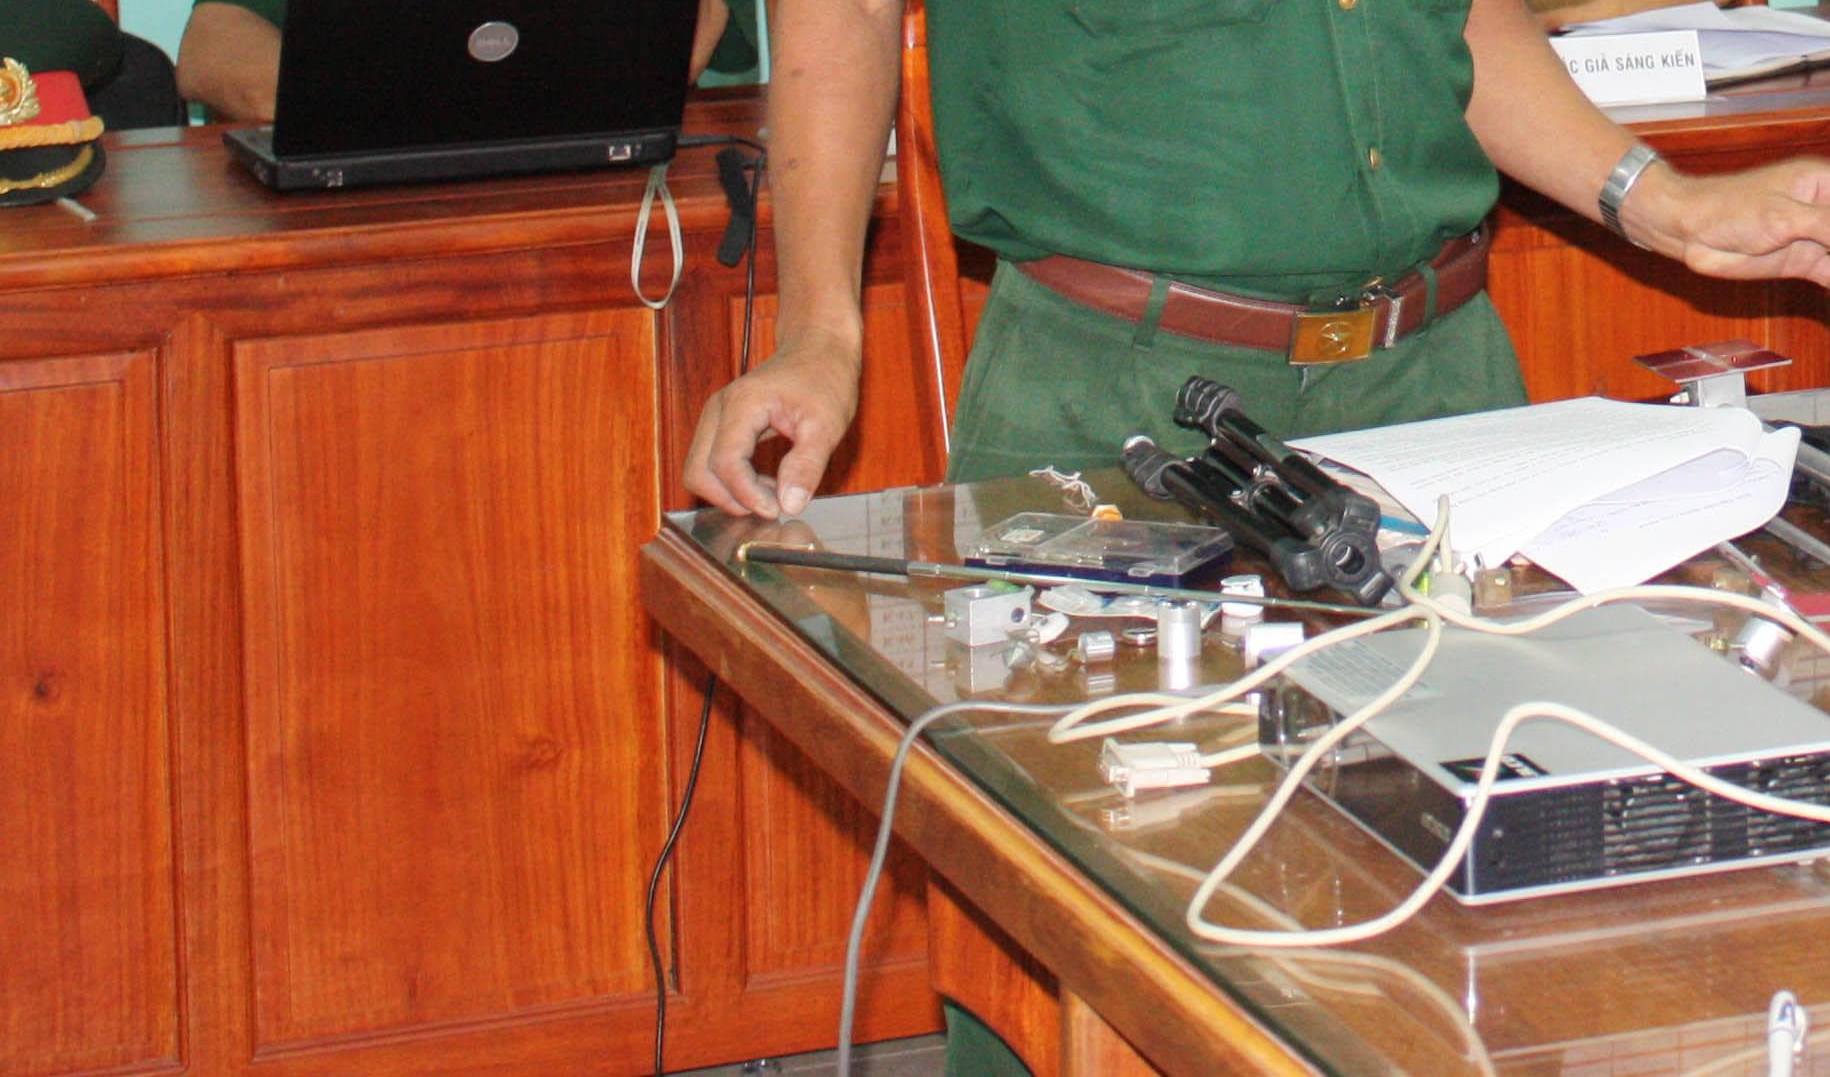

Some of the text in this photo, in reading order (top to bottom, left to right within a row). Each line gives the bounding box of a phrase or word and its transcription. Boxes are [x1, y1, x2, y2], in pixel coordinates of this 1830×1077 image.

[1585, 51, 1610, 74] GIẢ
[1616, 51, 1655, 72] SÁNG
[1661, 47, 1695, 68] KIẾN
